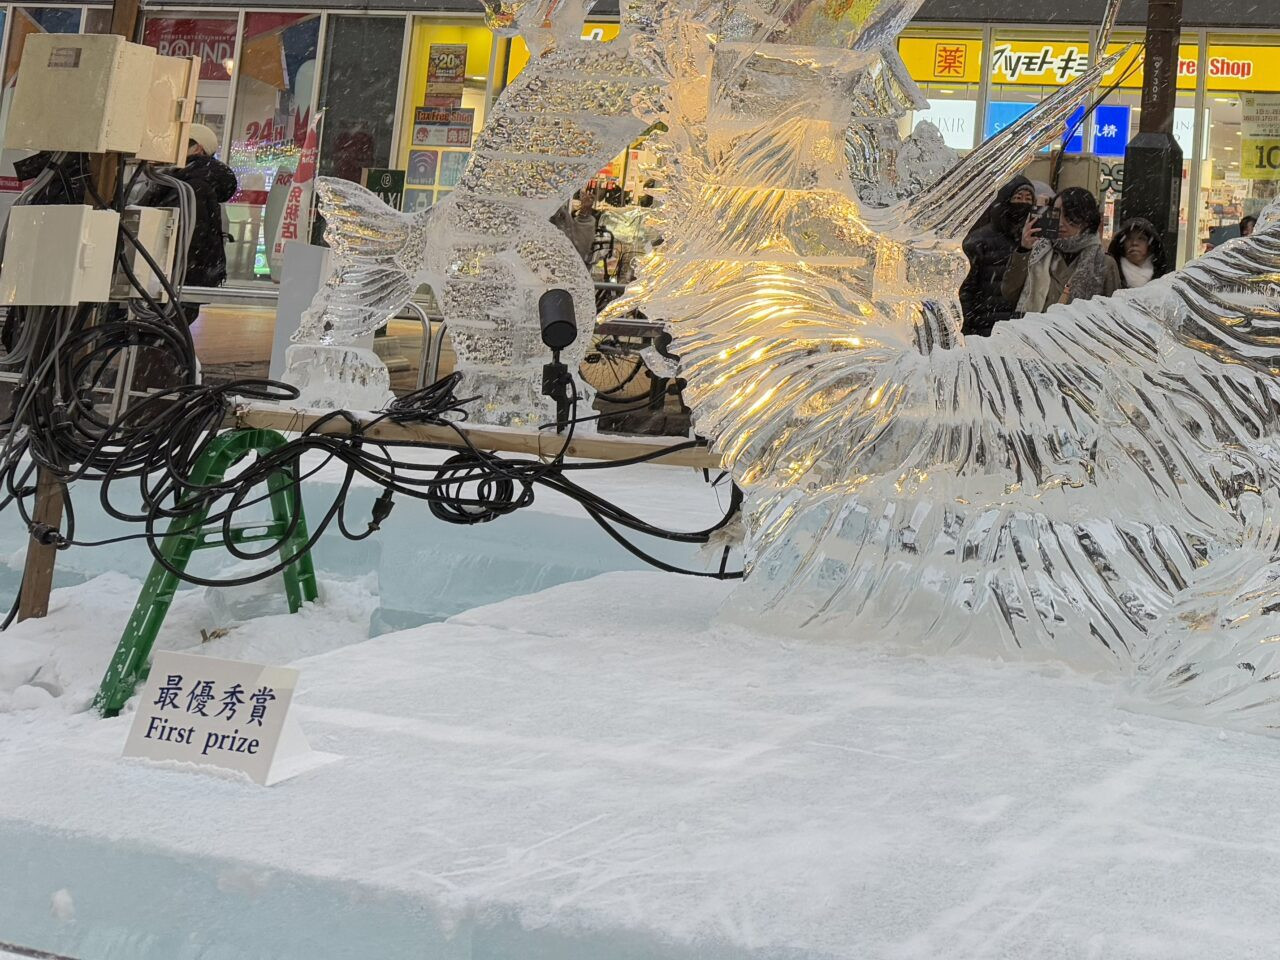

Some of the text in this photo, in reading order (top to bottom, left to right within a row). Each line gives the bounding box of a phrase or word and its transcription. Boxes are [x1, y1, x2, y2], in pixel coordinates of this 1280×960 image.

[938, 46, 964, 76] 薬
[1209, 58, 1253, 78] Shop
[416, 110, 431, 122] Tax
[153, 674, 277, 727] 最優秀賞
[144, 716, 260, 756] First prize
